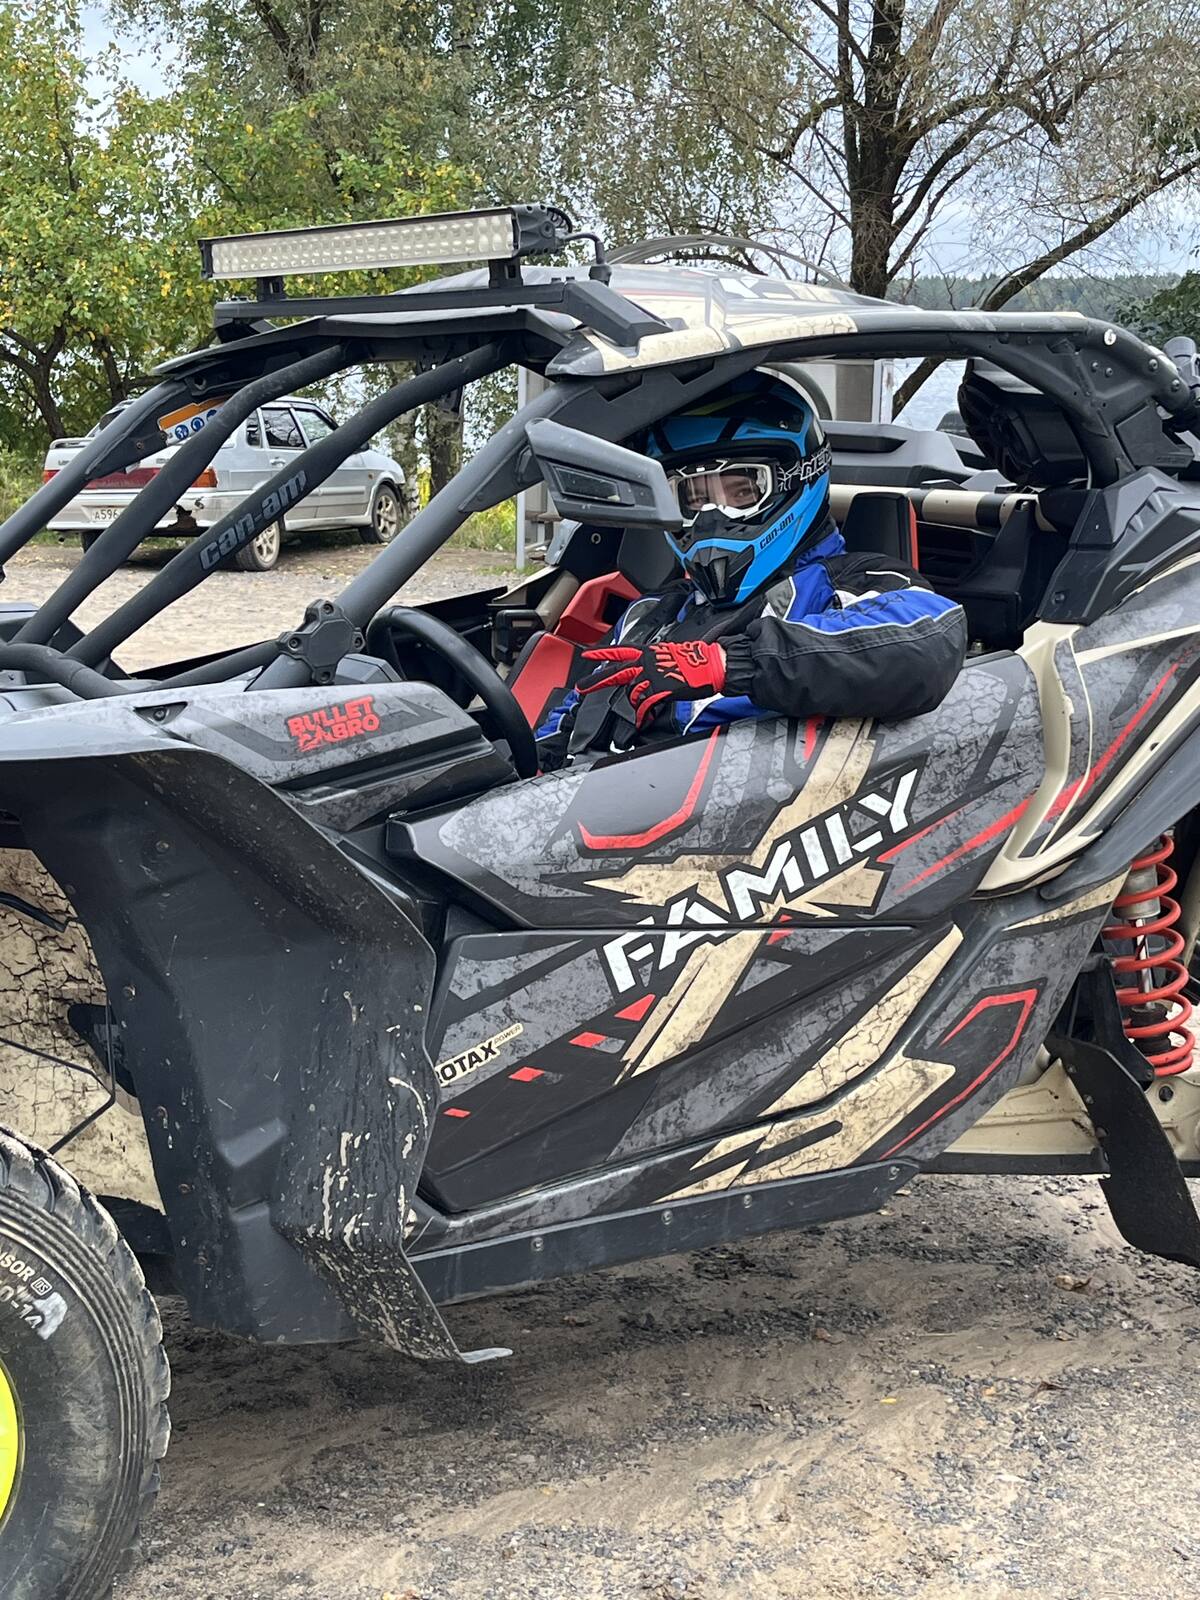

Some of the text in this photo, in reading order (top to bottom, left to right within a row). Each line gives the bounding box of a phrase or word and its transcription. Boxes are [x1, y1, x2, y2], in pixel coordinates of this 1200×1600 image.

[200, 469, 307, 570] can-am
[760, 512, 795, 550] can-am
[287, 695, 374, 737] BULLET
[602, 768, 918, 993] FAMILY
